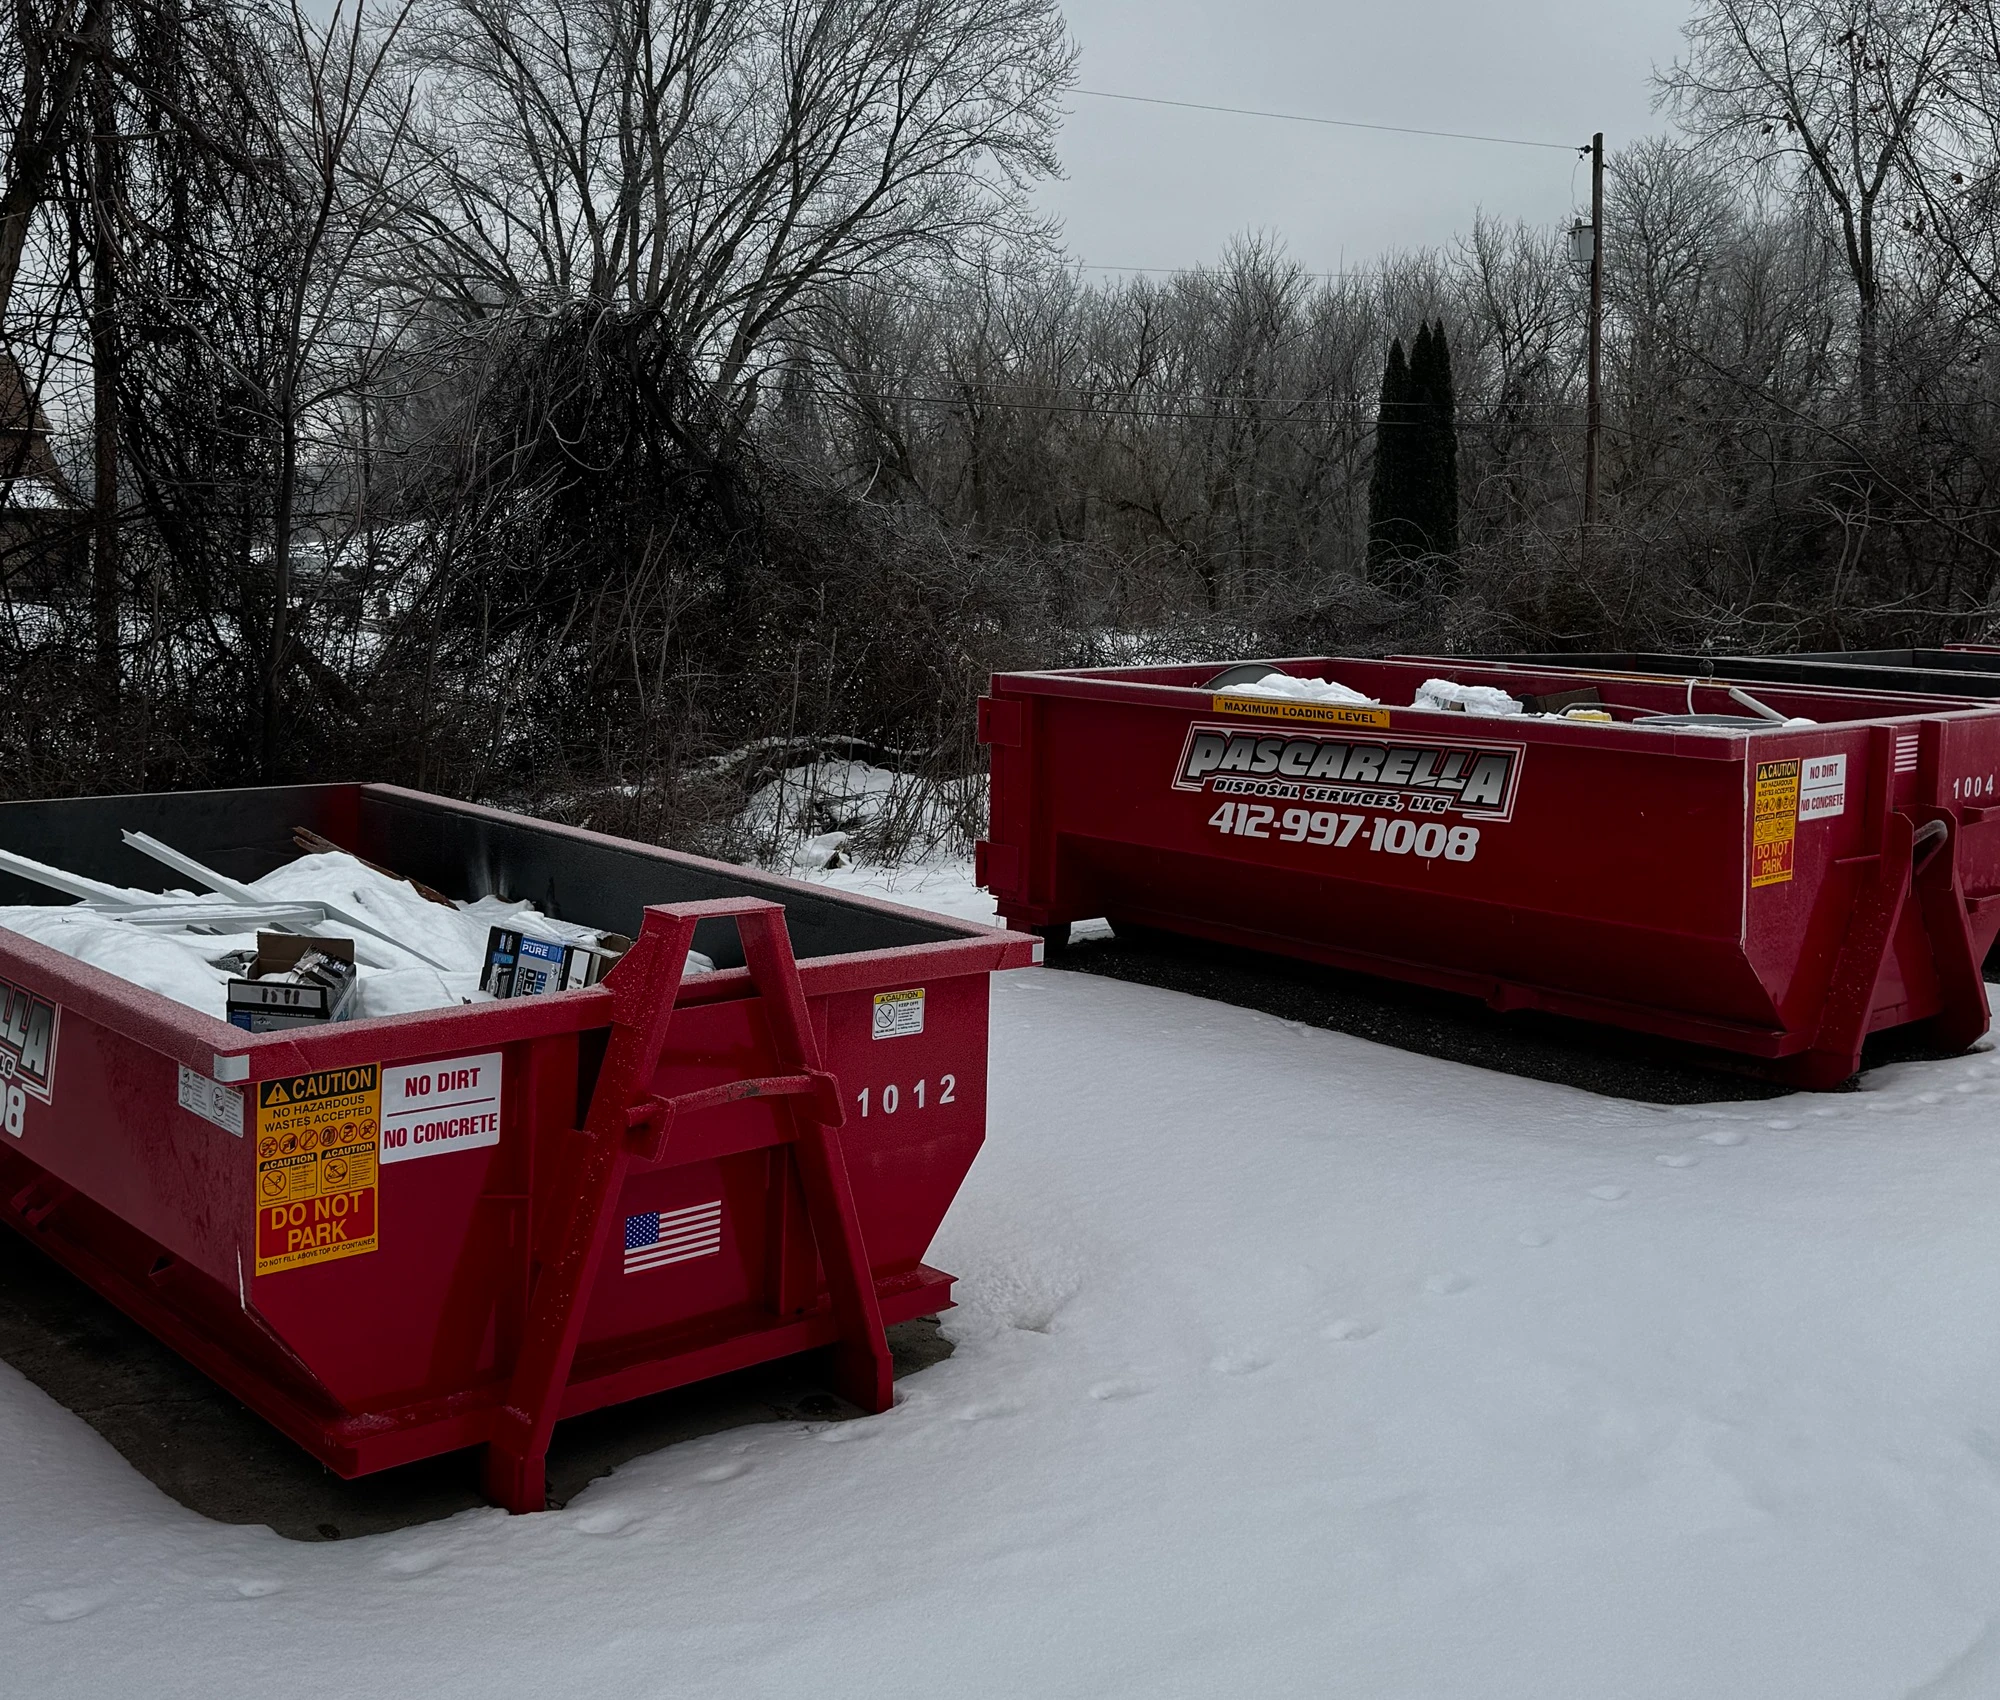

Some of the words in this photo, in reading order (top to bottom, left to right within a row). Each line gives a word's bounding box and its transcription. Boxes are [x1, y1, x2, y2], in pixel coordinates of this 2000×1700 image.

[1224, 702, 1278, 716] MAXIMUM
[1282, 707, 1334, 720] LOADING
[1338, 712, 1376, 724] LEVEL
[1186, 735, 1509, 805] PASCARELLA
[1768, 762, 1797, 778] CAUTION
[1809, 765, 1820, 779] NO
[1821, 763, 1838, 777] DIRT
[1213, 780, 1299, 800] DISPOSAL
[1304, 788, 1404, 812] SERVICES,
[1409, 796, 1449, 814] LLC
[1953, 774, 1994, 799] 1004
[1800, 798, 1810, 812] NO
[1811, 793, 1844, 810] CONCRETE
[1757, 844, 1770, 860] DO
[1771, 841, 1789, 857] NOT
[1762, 857, 1782, 875] PARK
[521, 943, 548, 957] PURE
[885, 991, 919, 1002] CAUTION
[292, 1068, 372, 1099] CAUTION
[405, 1074, 431, 1098] NO
[437, 1067, 481, 1093] DIRT
[272, 1108, 290, 1119] NO
[294, 1095, 365, 1115] HAZARDOUS
[857, 1073, 956, 1117] 1012
[264, 1116, 311, 1132] WASTES
[314, 1106, 373, 1124] ACCEPTED
[384, 1127, 408, 1149] NO
[413, 1112, 498, 1144] CONCRETE
[270, 1154, 315, 1169] CAUTION
[331, 1142, 373, 1158] CAUTION
[271, 1202, 307, 1230] DO
[315, 1190, 363, 1221] NOT
[288, 1218, 348, 1252] PARK
[258, 1260, 269, 1269] DO
[269, 1257, 282, 1266] NOT
[283, 1254, 296, 1263] FILL
[297, 1249, 318, 1260] ABOVE
[319, 1247, 331, 1255] TOP
[332, 1244, 341, 1252] OF
[341, 1238, 376, 1251] CONTAINER
